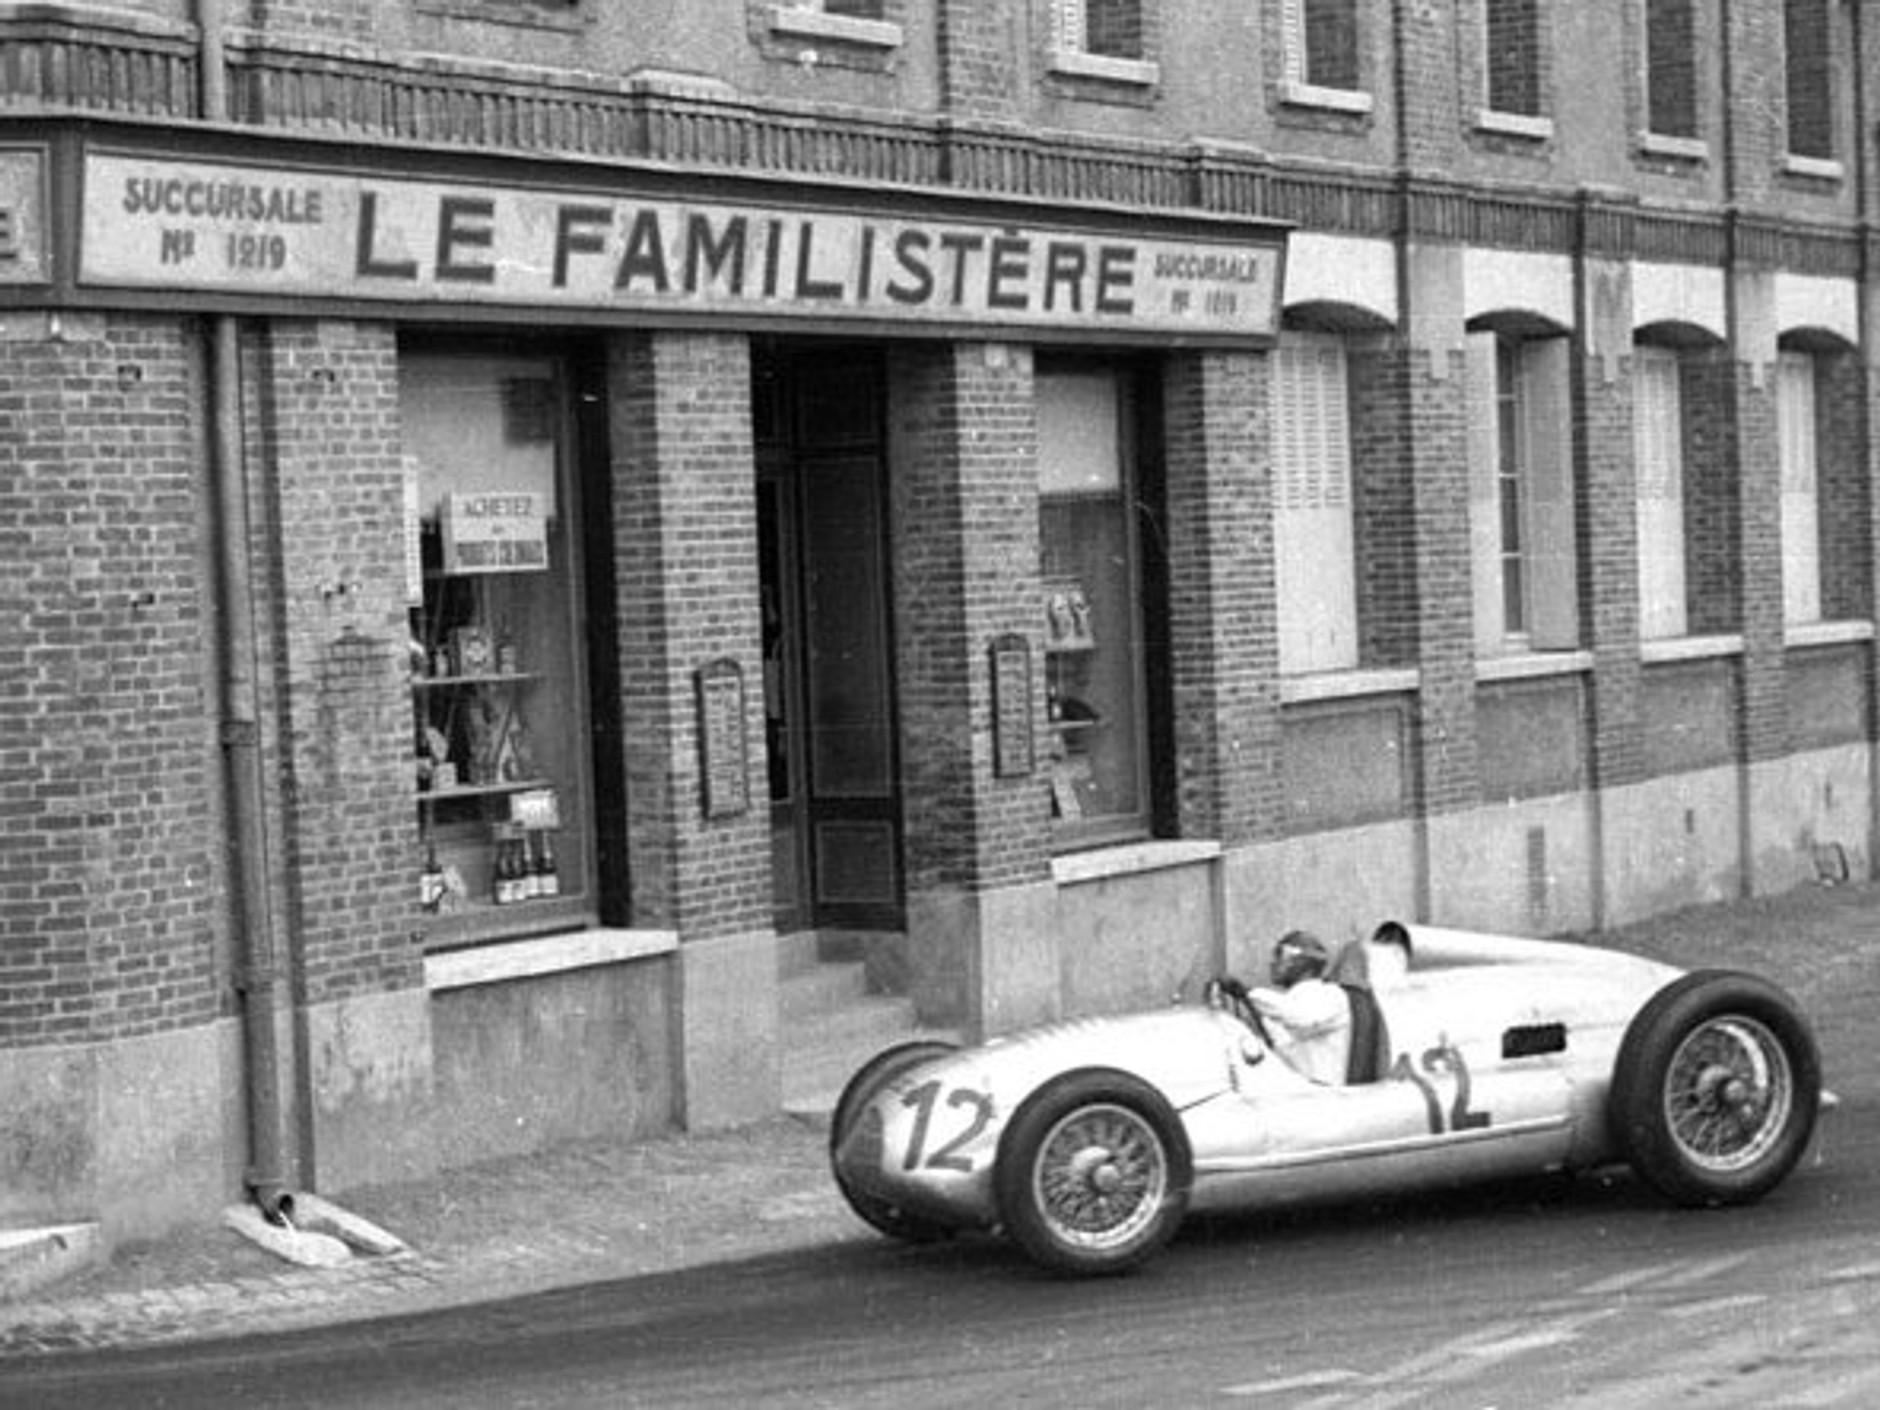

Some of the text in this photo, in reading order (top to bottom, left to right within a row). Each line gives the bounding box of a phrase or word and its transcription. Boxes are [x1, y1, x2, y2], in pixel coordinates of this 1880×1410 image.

[123, 177, 322, 223] SUCCURSALE
[228, 231, 286, 270] 1219
[355, 193, 1136, 315] LE FAMILISTÈRE
[1154, 253, 1257, 284] SUCCURSALE
[1394, 1046, 1491, 1135] 12
[902, 1080, 996, 1172] 12
